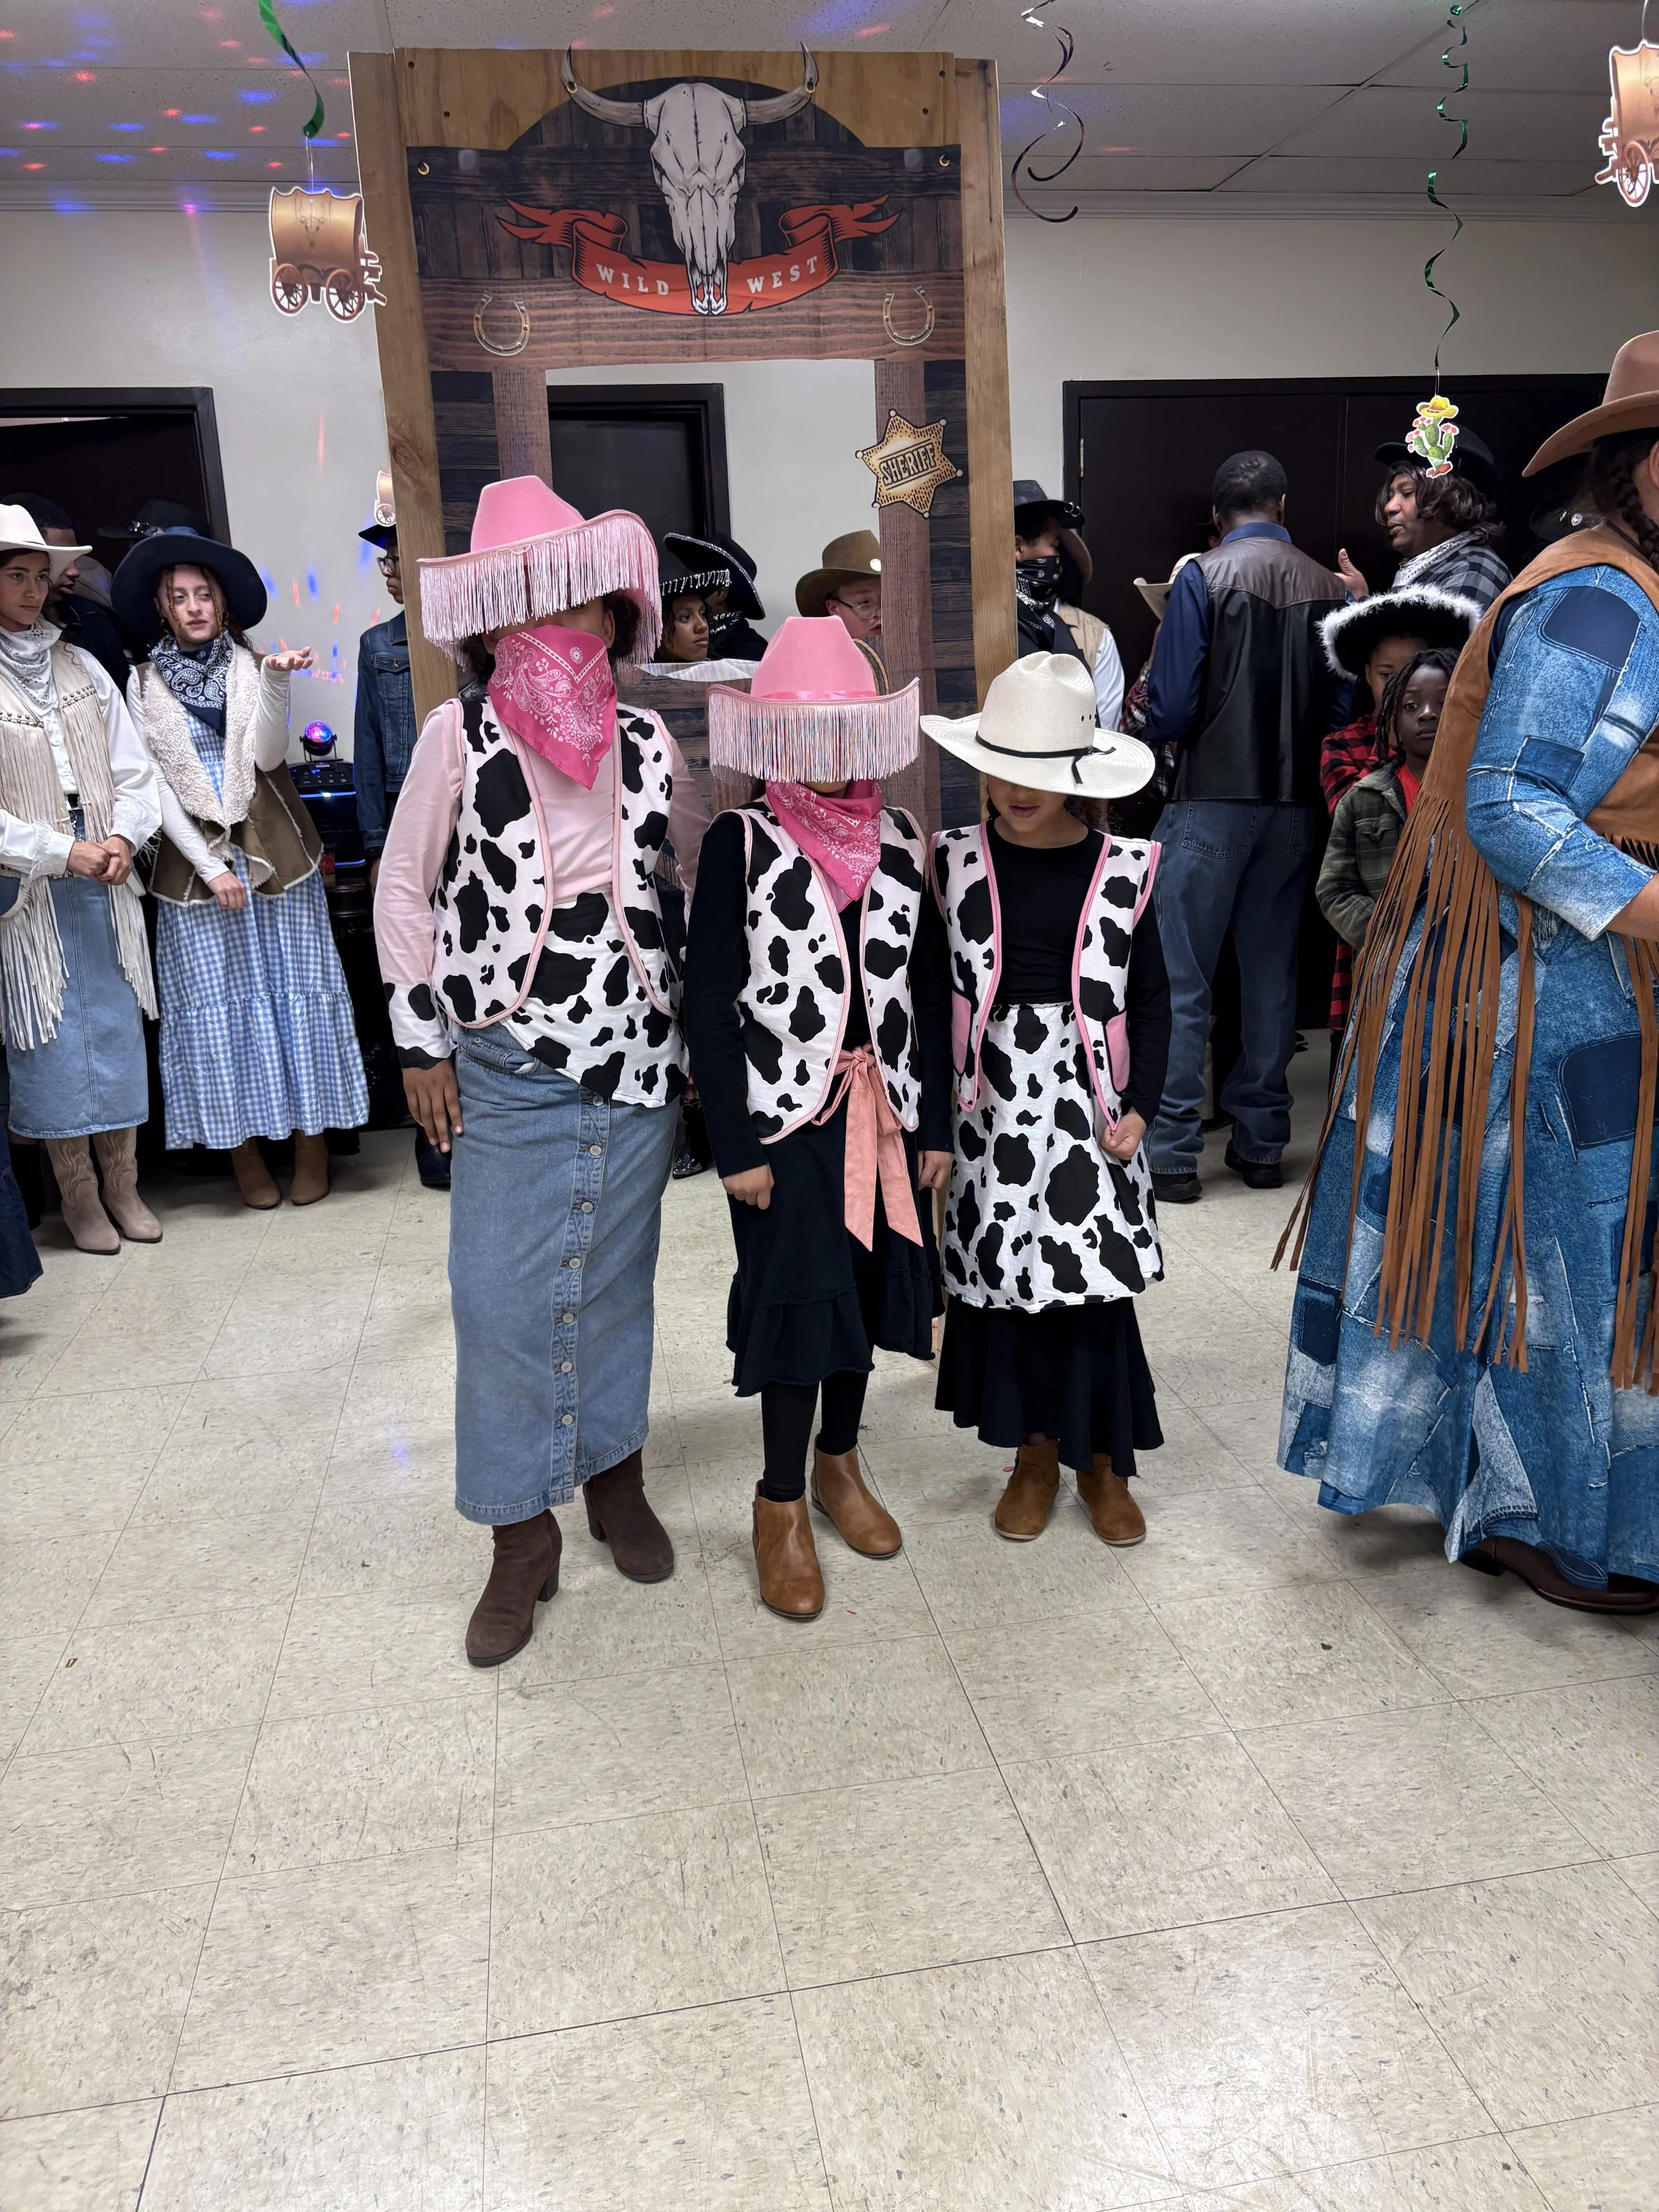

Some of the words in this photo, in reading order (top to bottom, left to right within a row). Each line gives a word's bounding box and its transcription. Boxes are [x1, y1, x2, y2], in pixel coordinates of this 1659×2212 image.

[596, 263, 669, 295] WILD
[747, 256, 818, 294] WEST
[879, 443, 936, 486] SHERIFF
